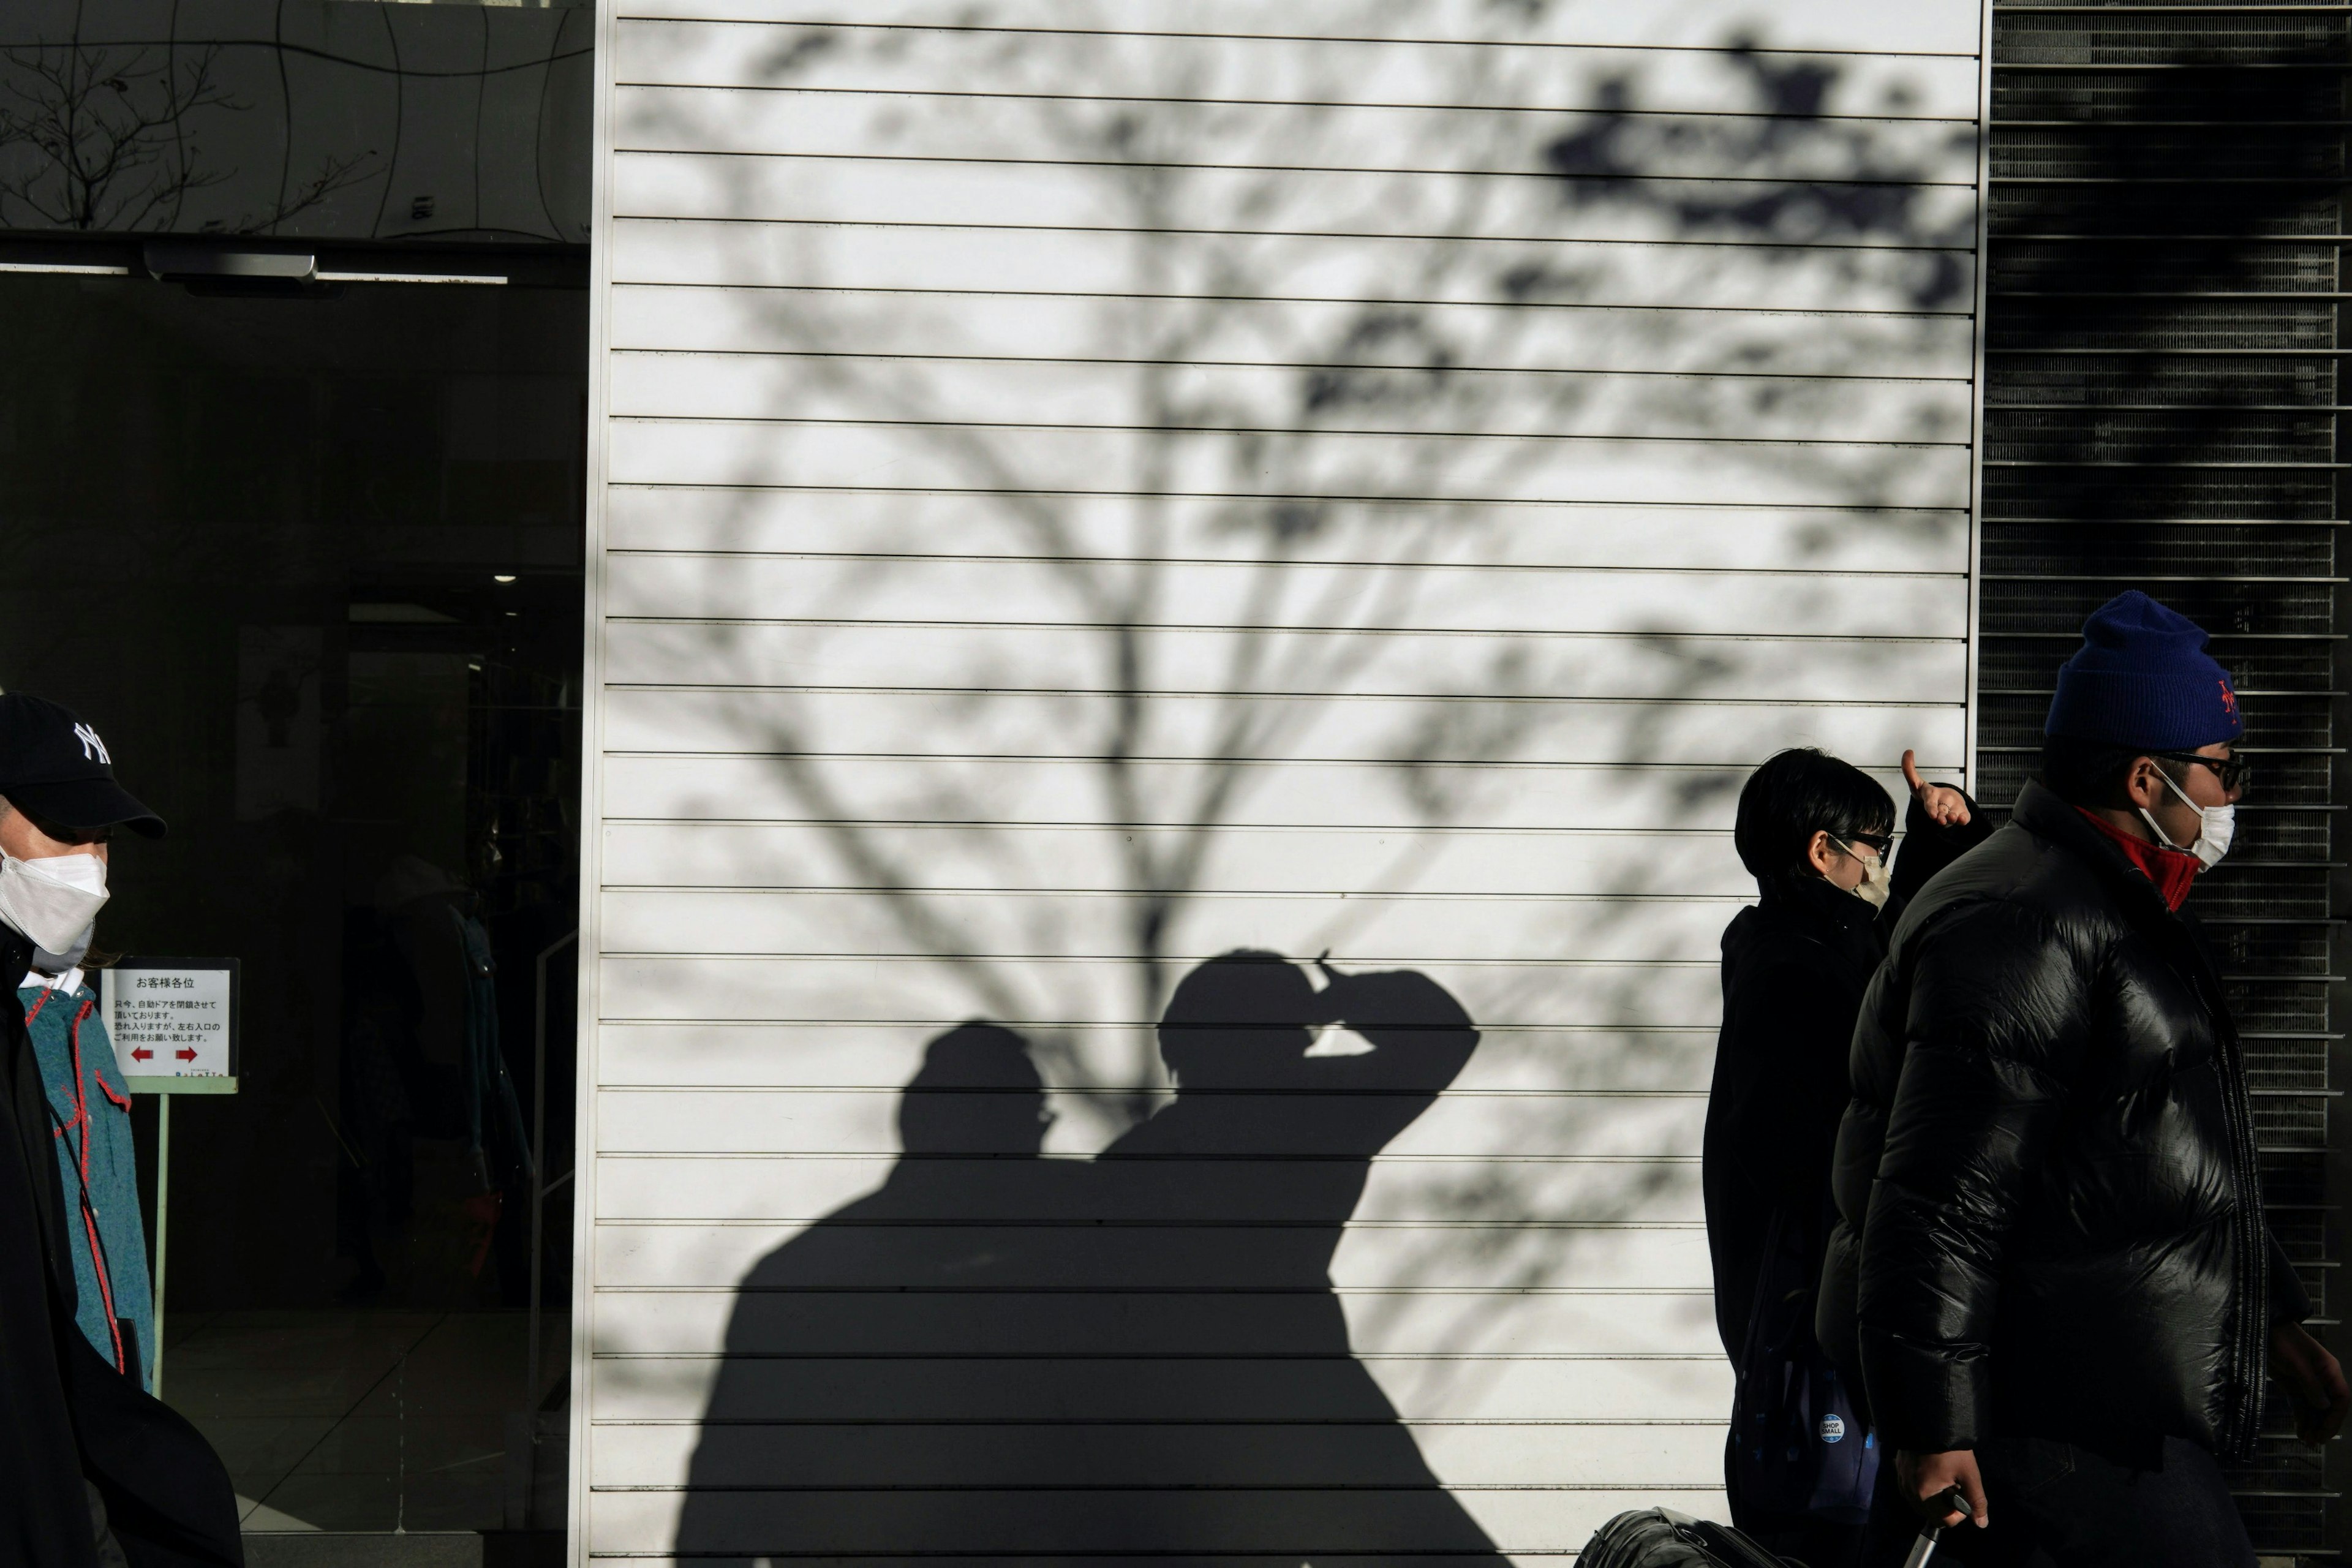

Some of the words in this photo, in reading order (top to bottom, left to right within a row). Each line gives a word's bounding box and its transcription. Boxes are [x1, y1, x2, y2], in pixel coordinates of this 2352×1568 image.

[74, 722, 111, 764] NY
[137, 977, 194, 989] お客様各位
[115, 1000, 216, 1009] 只今、自動ドアを閉鎖させて
[115, 1011, 173, 1020] 頂いております。
[114, 1022, 221, 1031] 恐れ入りますが、左右入口の
[114, 1033, 207, 1042] ご利用をお願い致します。
